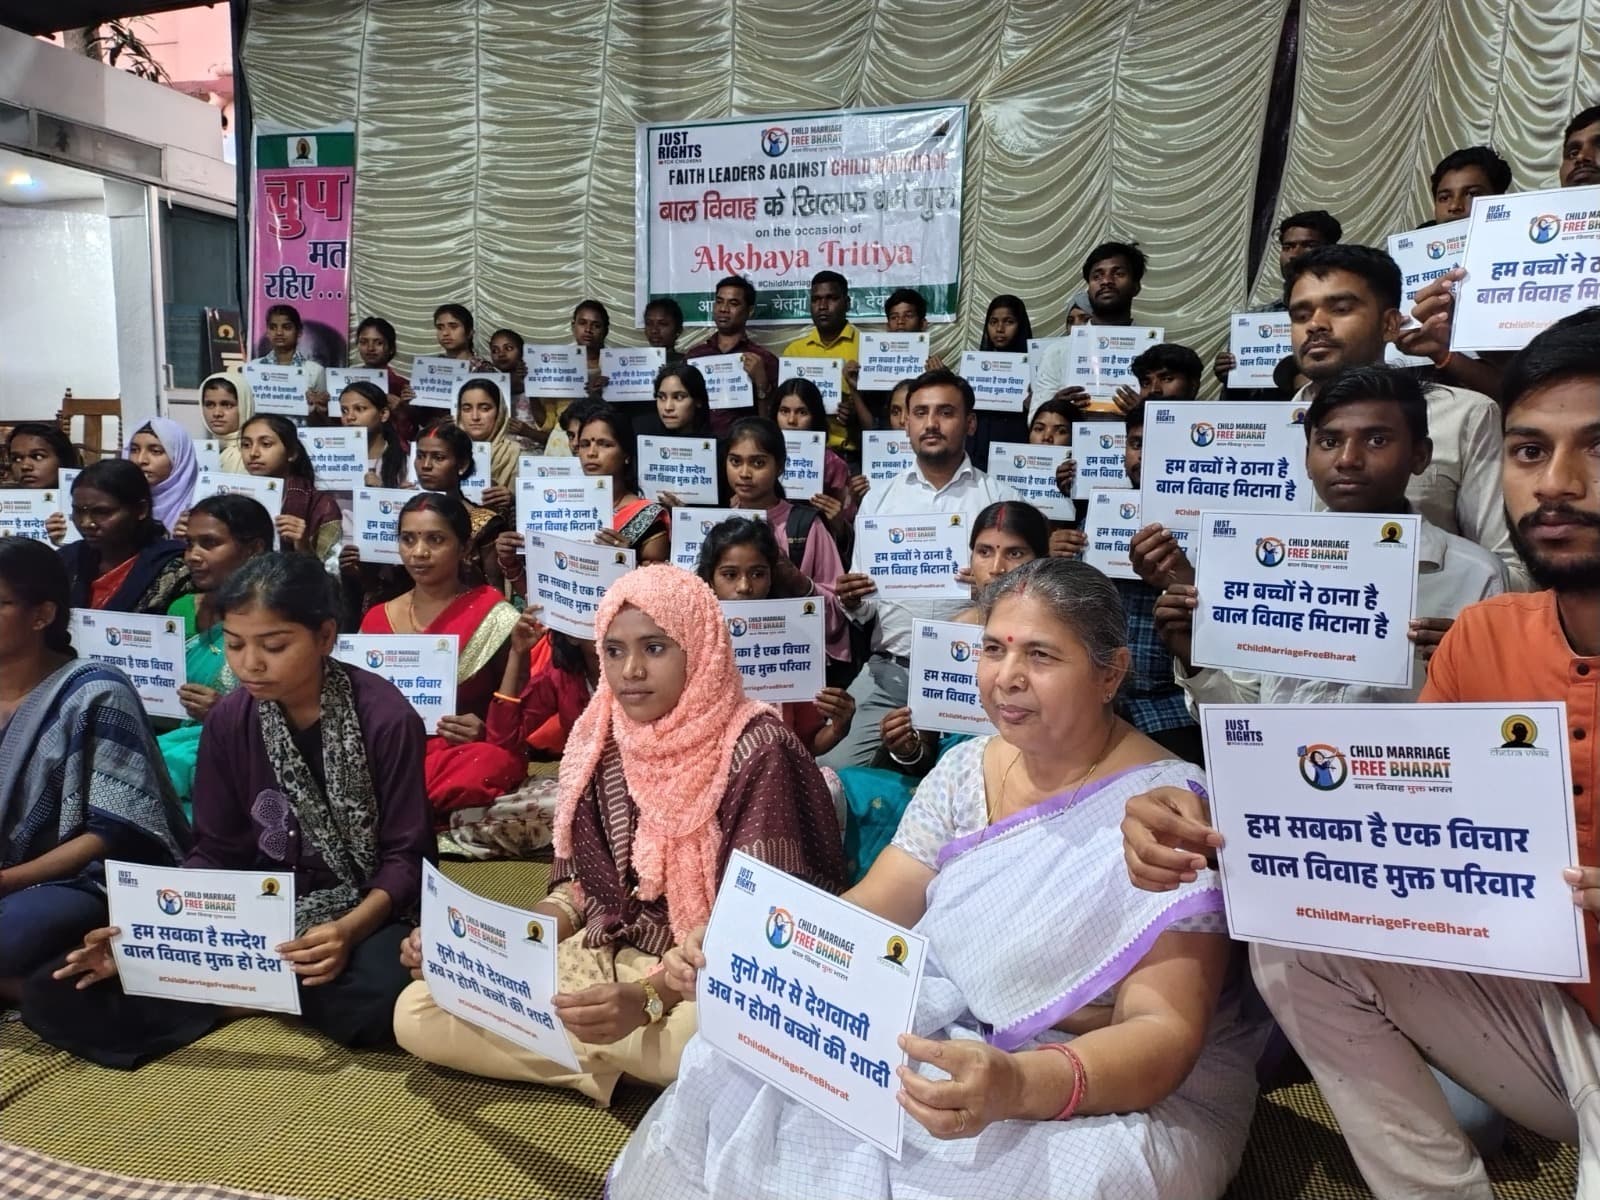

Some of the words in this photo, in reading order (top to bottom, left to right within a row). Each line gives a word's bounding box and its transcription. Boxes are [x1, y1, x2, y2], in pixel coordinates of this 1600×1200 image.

[659, 132, 688, 145] JUST
[792, 135, 809, 145] FREE
[658, 145, 701, 159] RIGHTS
[669, 168, 704, 185] FAITH
[709, 165, 765, 183] LEADERS
[770, 160, 826, 180] AGAINST
[831, 158, 870, 176] CHILD
[264, 173, 349, 240] चुप
[659, 200, 698, 222] बाल
[703, 190, 758, 220] विवाह
[764, 188, 785, 216] के
[792, 185, 864, 217] खिलाफ
[755, 229, 769, 237] on
[773, 227, 791, 237] the
[795, 225, 846, 236] occasion
[850, 223, 862, 234] of
[308, 241, 347, 268] मत
[691, 243, 809, 276] Akshaya
[818, 240, 913, 272] Tritiya
[1492, 262, 1519, 280] हम
[1523, 253, 1568, 276] बच्चों
[1571, 252, 1586, 273] ने
[1477, 288, 1515, 303] बाल
[1518, 281, 1574, 303] विवाह
[1240, 347, 1251, 355] हम
[1086, 456, 1098, 466] हम
[1166, 459, 1185, 474] हम
[1189, 457, 1224, 475] बच्चों
[1226, 457, 1238, 475] ने
[1241, 461, 1273, 476] ठाना
[1277, 460, 1289, 479] है
[1082, 468, 1097, 478] बाल
[1100, 468, 1123, 479] विवाह
[1156, 479, 1184, 494] बाल
[1188, 479, 1229, 497] विवाह
[1233, 482, 1281, 499] मिटाना
[1284, 482, 1297, 501] है
[530, 511, 542, 520] हम
[573, 510, 590, 518] ठाना
[592, 507, 598, 519] है
[367, 520, 378, 529] हम
[1097, 527, 1109, 537] हम
[1095, 541, 1112, 551] बाल
[1288, 538, 1309, 547] CHILD
[1311, 539, 1349, 549] MARRIAGE
[875, 552, 889, 562] हम
[891, 549, 912, 562] बच्चों
[913, 549, 921, 561] ने
[923, 551, 943, 561] ठाना
[945, 548, 952, 561] है
[1288, 548, 1310, 558] FREE
[1311, 550, 1349, 561] BHARAT
[870, 565, 890, 576] बाल
[892, 563, 918, 576] विवाह
[920, 562, 950, 575] मिटाना
[951, 561, 959, 574] है
[538, 573, 548, 584] हम
[572, 581, 577, 595] है
[579, 585, 594, 596] एक
[1224, 581, 1249, 599] हम
[1253, 579, 1295, 603] बच्चों
[1299, 580, 1314, 603] ने
[1317, 586, 1360, 606] ठाना
[1365, 583, 1379, 611] है
[1213, 605, 1248, 625] बाल
[1252, 605, 1304, 631] विवाह
[1308, 612, 1370, 635] मिटाना
[1374, 612, 1389, 638] है
[754, 643, 761, 658] है
[763, 646, 780, 656] एक
[783, 642, 810, 655] विचार
[128, 655, 135, 668] है
[135, 658, 149, 668] एक
[151, 658, 173, 671] विचार
[759, 663, 777, 677] मुक्त
[780, 659, 811, 672] परिवार
[397, 679, 414, 688] एक
[416, 676, 442, 688] विचार
[924, 669, 939, 681] हम
[941, 671, 972, 685] सबका
[412, 693, 442, 705] परिवार
[922, 687, 944, 699] बाल
[946, 688, 976, 704] विवाह
[1225, 719, 1250, 731] JUST
[1226, 731, 1263, 742] RIGHTS
[1350, 745, 1383, 758] CHILD
[1386, 745, 1450, 760] MARRIAGE
[1352, 760, 1387, 777] FREE
[1390, 762, 1451, 779] BHARAT
[1354, 783, 1374, 791] बाल
[1376, 782, 1404, 792] विवाह
[1245, 813, 1280, 838] हम
[1285, 815, 1362, 843] सबका
[1367, 811, 1387, 847] है
[1392, 821, 1440, 846] एक
[1448, 817, 1529, 853] विचार
[1248, 853, 1299, 878] बाल
[1304, 852, 1378, 888] विवाह
[1384, 863, 1435, 898] मुक्त
[1440, 862, 1536, 899] परिवार
[1296, 906, 1490, 939] #ChildMarriageFreeBharat
[132, 923, 154, 939] हम
[157, 926, 203, 944] सबका
[206, 925, 219, 947] है
[220, 929, 266, 950] सन्देश
[123, 944, 154, 960] बाल
[157, 945, 201, 966] विवाह
[204, 953, 233, 971] मुक्त
[236, 952, 253, 970] हो
[255, 954, 281, 973] देश
[436, 942, 456, 964] सुनो
[456, 950, 474, 972] गौर
[475, 960, 486, 978] से
[487, 966, 531, 1000] देशवासी
[427, 960, 445, 980] अब
[446, 970, 456, 983] न
[457, 972, 481, 995] होगी
[482, 985, 508, 1007] बच्चों
[508, 996, 526, 1016] की
[527, 1008, 555, 1031] शादी
[730, 953, 760, 984] सुनो
[761, 965, 786, 998] गौर
[788, 977, 803, 1006] से
[805, 985, 870, 1042] देशवासी
[707, 976, 731, 1004] अब
[735, 990, 746, 1011] न
[748, 994, 781, 1030] होगी
[783, 1015, 822, 1051] बच्चों
[823, 1033, 846, 1065] की
[849, 1052, 891, 1088] शादी
